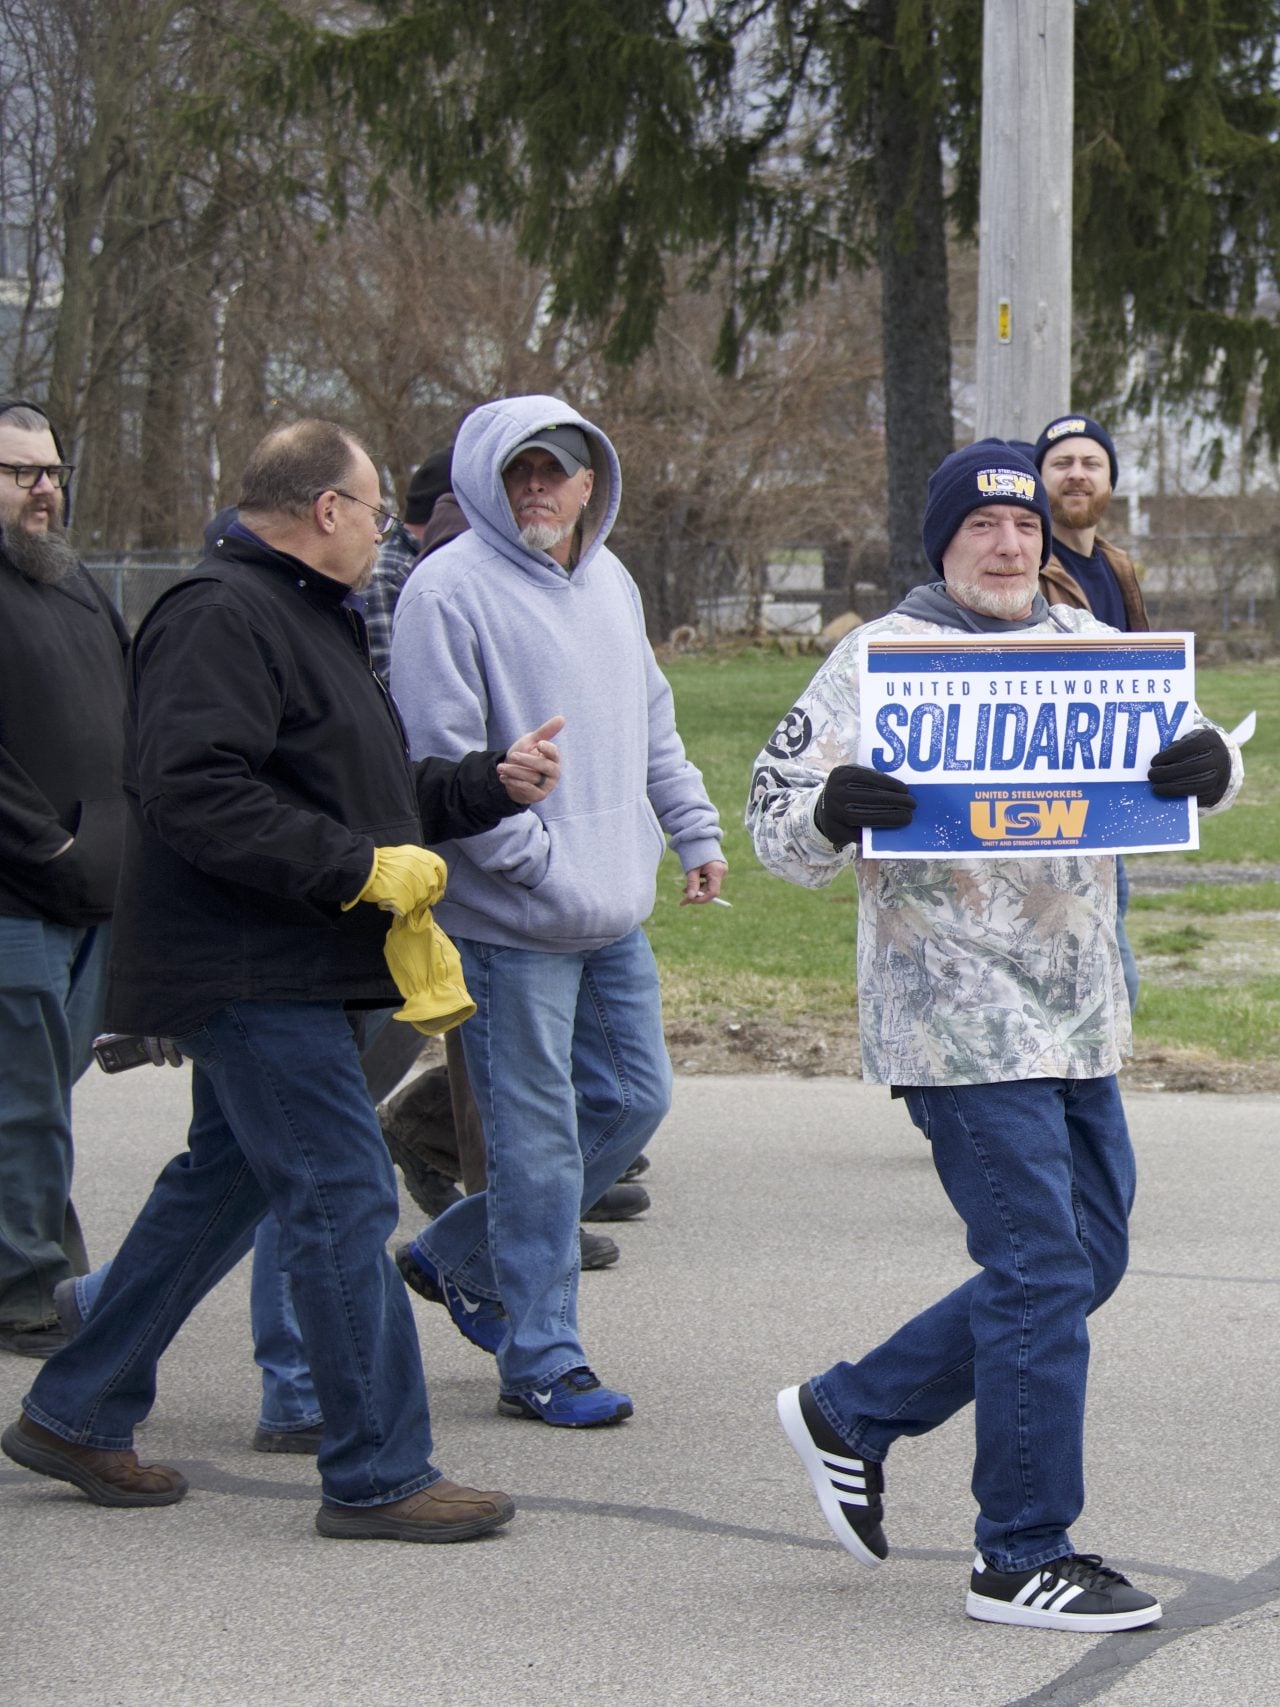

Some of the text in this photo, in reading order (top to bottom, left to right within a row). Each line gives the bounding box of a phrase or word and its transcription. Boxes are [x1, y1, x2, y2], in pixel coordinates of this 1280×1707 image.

[977, 474, 1036, 498] USW
[886, 679, 1171, 696] UNITED STEELWORKERS
[871, 701, 1189, 772] SOLIDARITY
[975, 790, 1083, 799] UNITED STEELWORKERS
[970, 800, 1089, 840] USW
